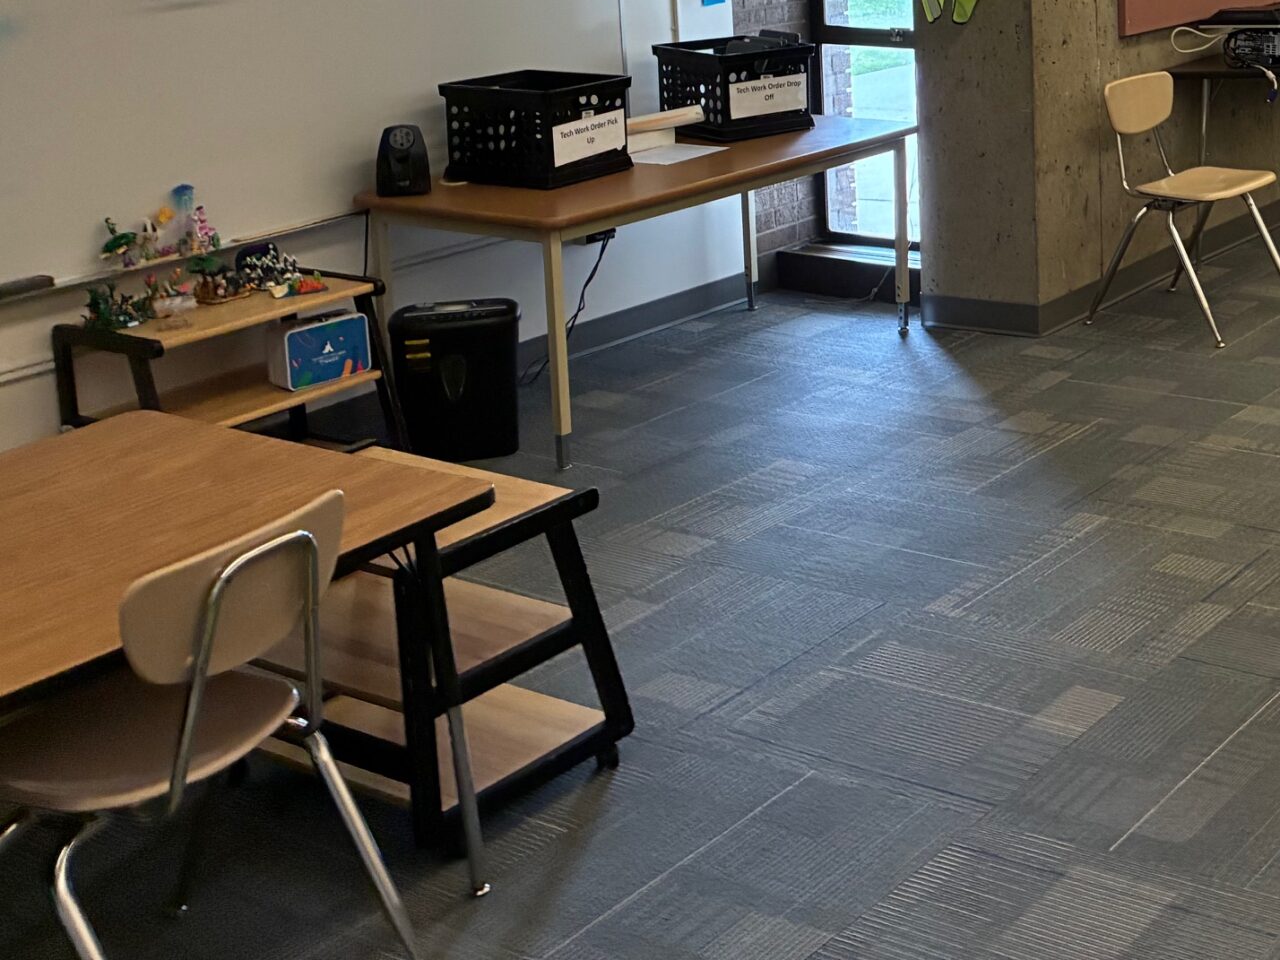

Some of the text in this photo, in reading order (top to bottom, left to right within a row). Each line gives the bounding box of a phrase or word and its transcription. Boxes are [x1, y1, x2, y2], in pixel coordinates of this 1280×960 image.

[751, 84, 766, 92] Work
[767, 82, 785, 90] Order
[787, 80, 801, 88] Drop
[560, 116, 619, 139] Tech Work Order Pick
[586, 136, 595, 144] Up
